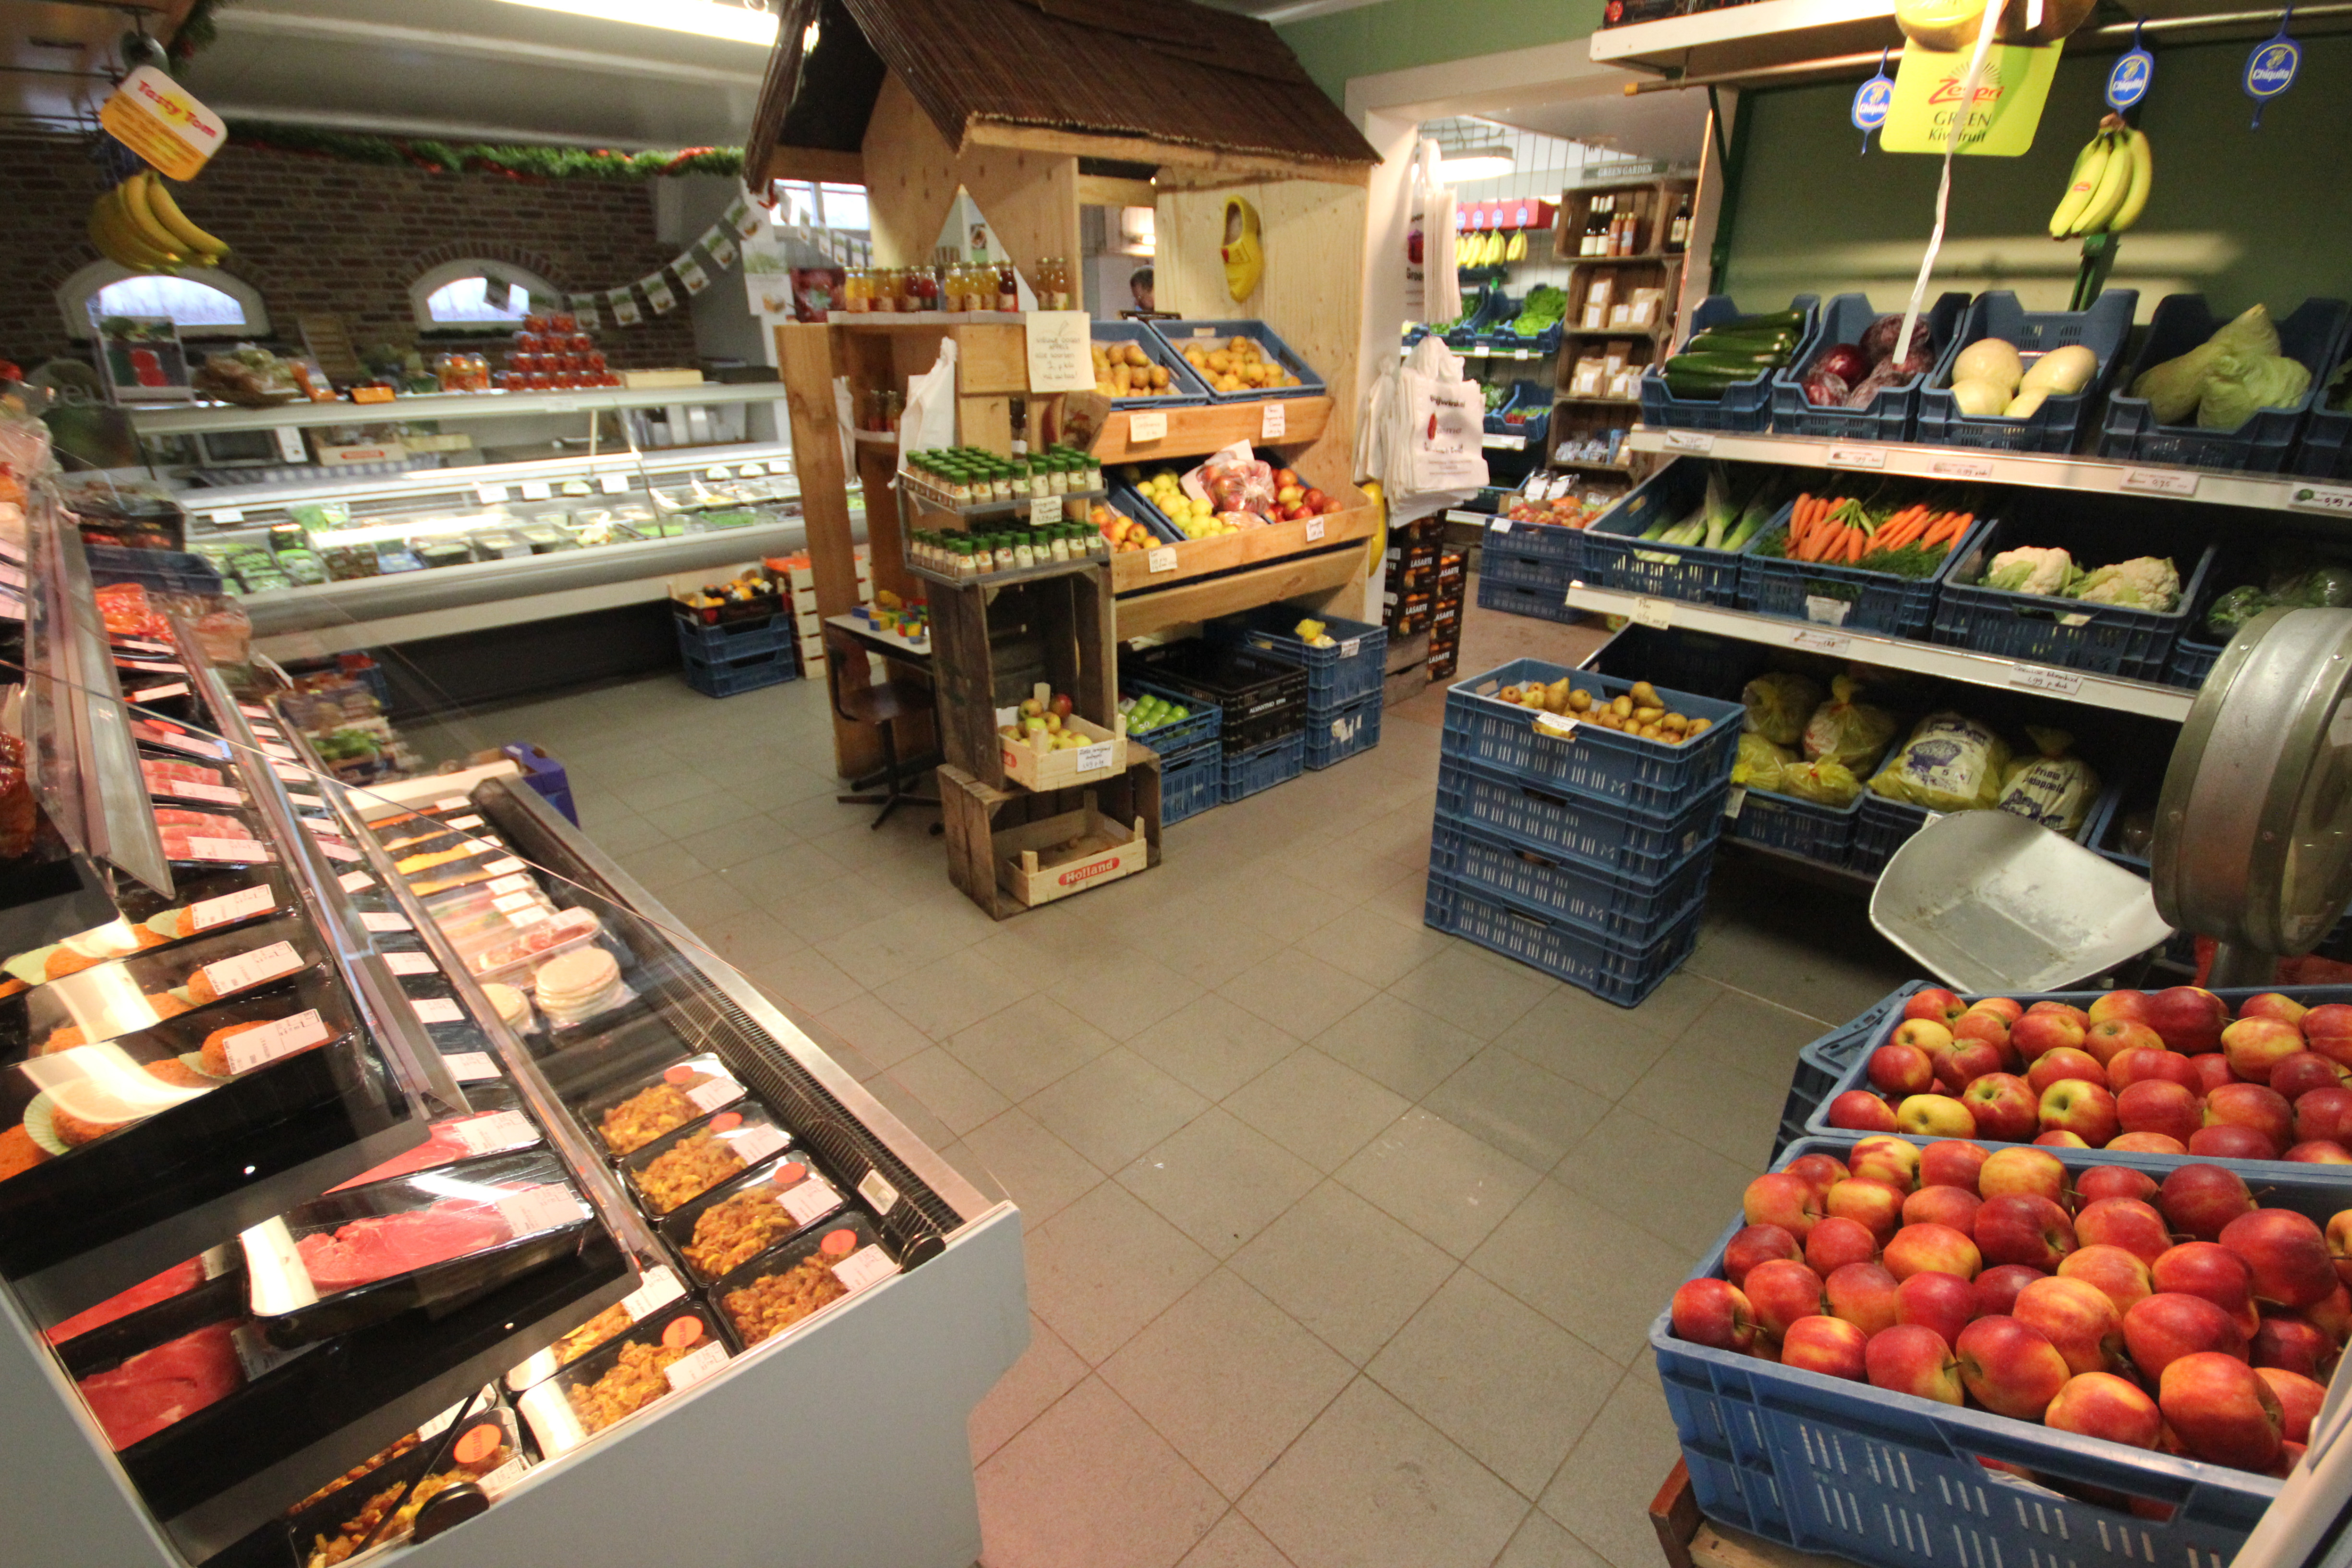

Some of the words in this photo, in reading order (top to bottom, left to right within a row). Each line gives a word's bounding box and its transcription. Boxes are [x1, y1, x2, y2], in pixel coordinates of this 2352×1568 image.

[2252, 68, 2291, 82] Chiquita
[1928, 78, 2005, 106] Zepri
[2112, 77, 2144, 92] Chiquita
[138, 79, 182, 115] Tasty
[185, 110, 218, 138] Tom
[1933, 110, 1992, 127] GREN
[1598, 166, 1622, 177] GREEN
[1623, 163, 1653, 174] GARDEN
[1410, 557, 1433, 568] LASARTE
[1406, 603, 1428, 615] LASARTE
[1428, 651, 1450, 664] LASARTE
[2035, 766, 2061, 781] Prima
[1064, 858, 1114, 885] Holland
